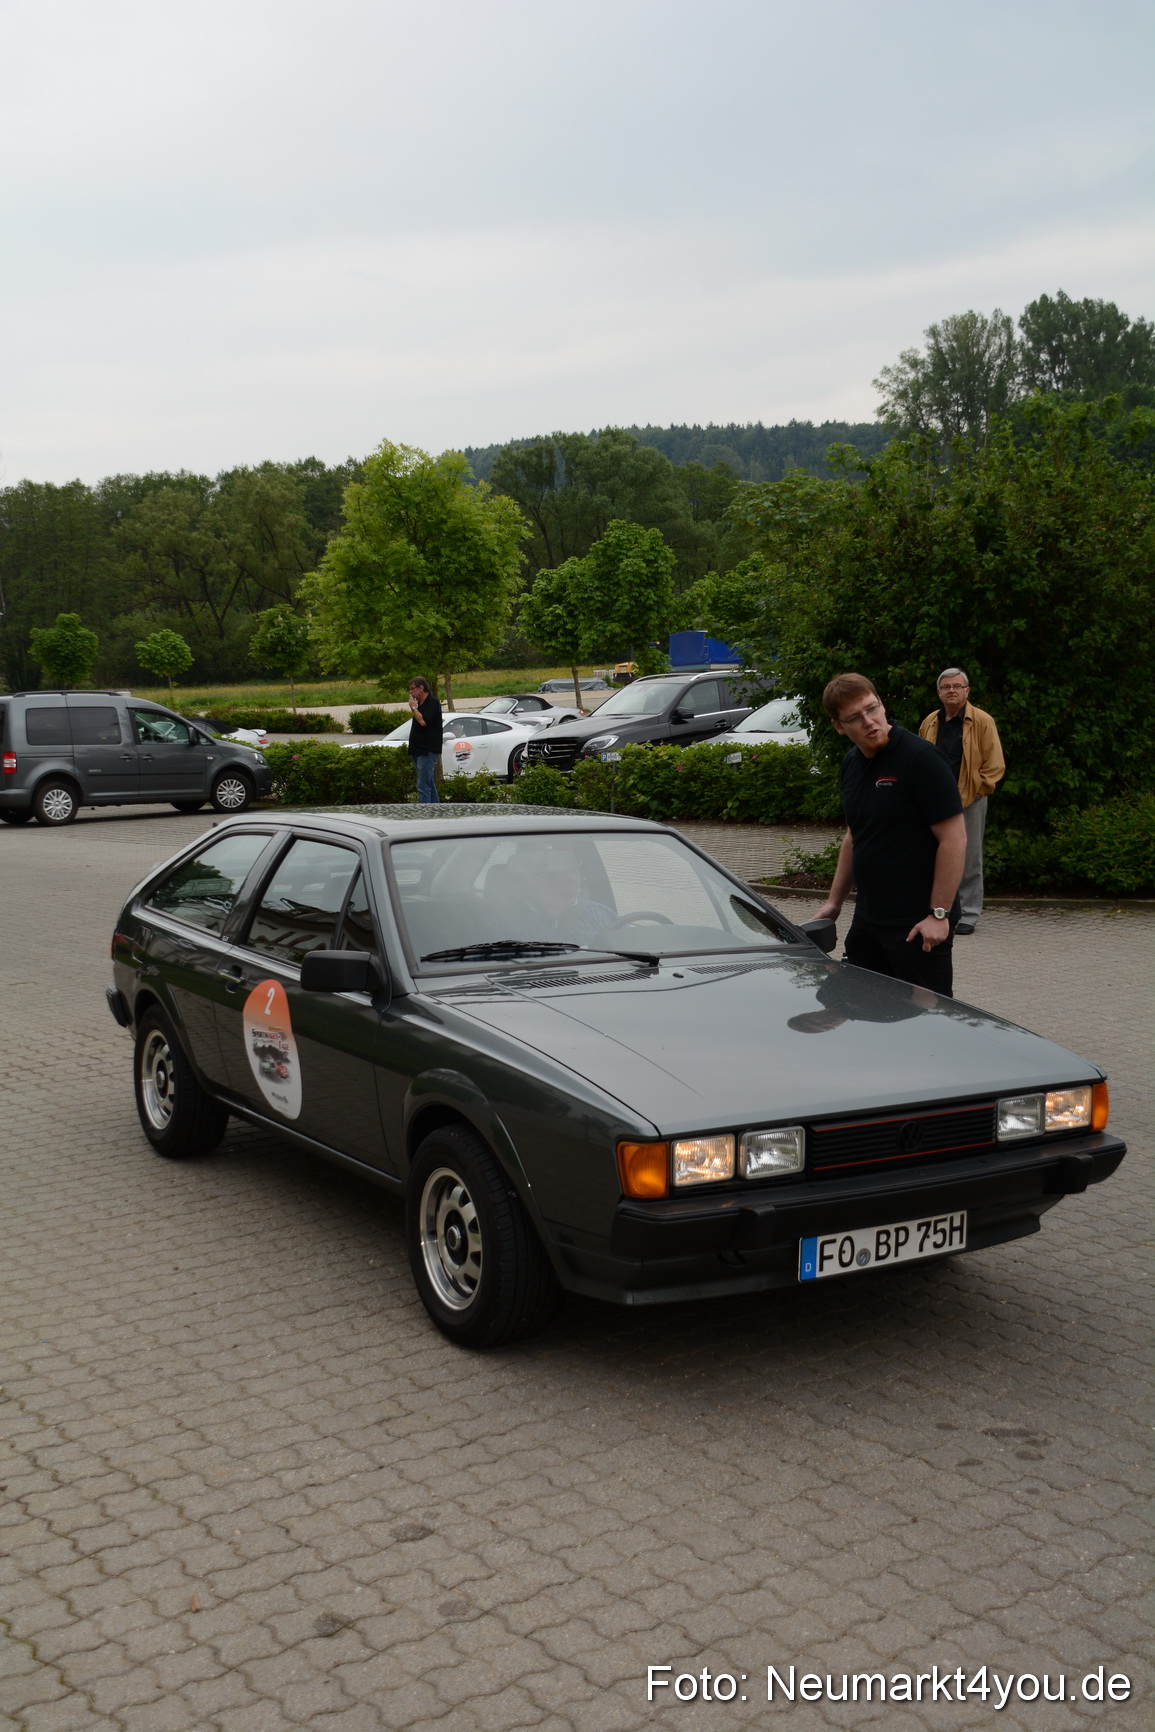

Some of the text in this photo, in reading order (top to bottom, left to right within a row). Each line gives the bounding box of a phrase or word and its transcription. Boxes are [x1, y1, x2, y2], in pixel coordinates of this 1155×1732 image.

[264, 987, 275, 1015] 2
[818, 1213, 964, 1272] FO BP 75H
[805, 1262, 812, 1272] D
